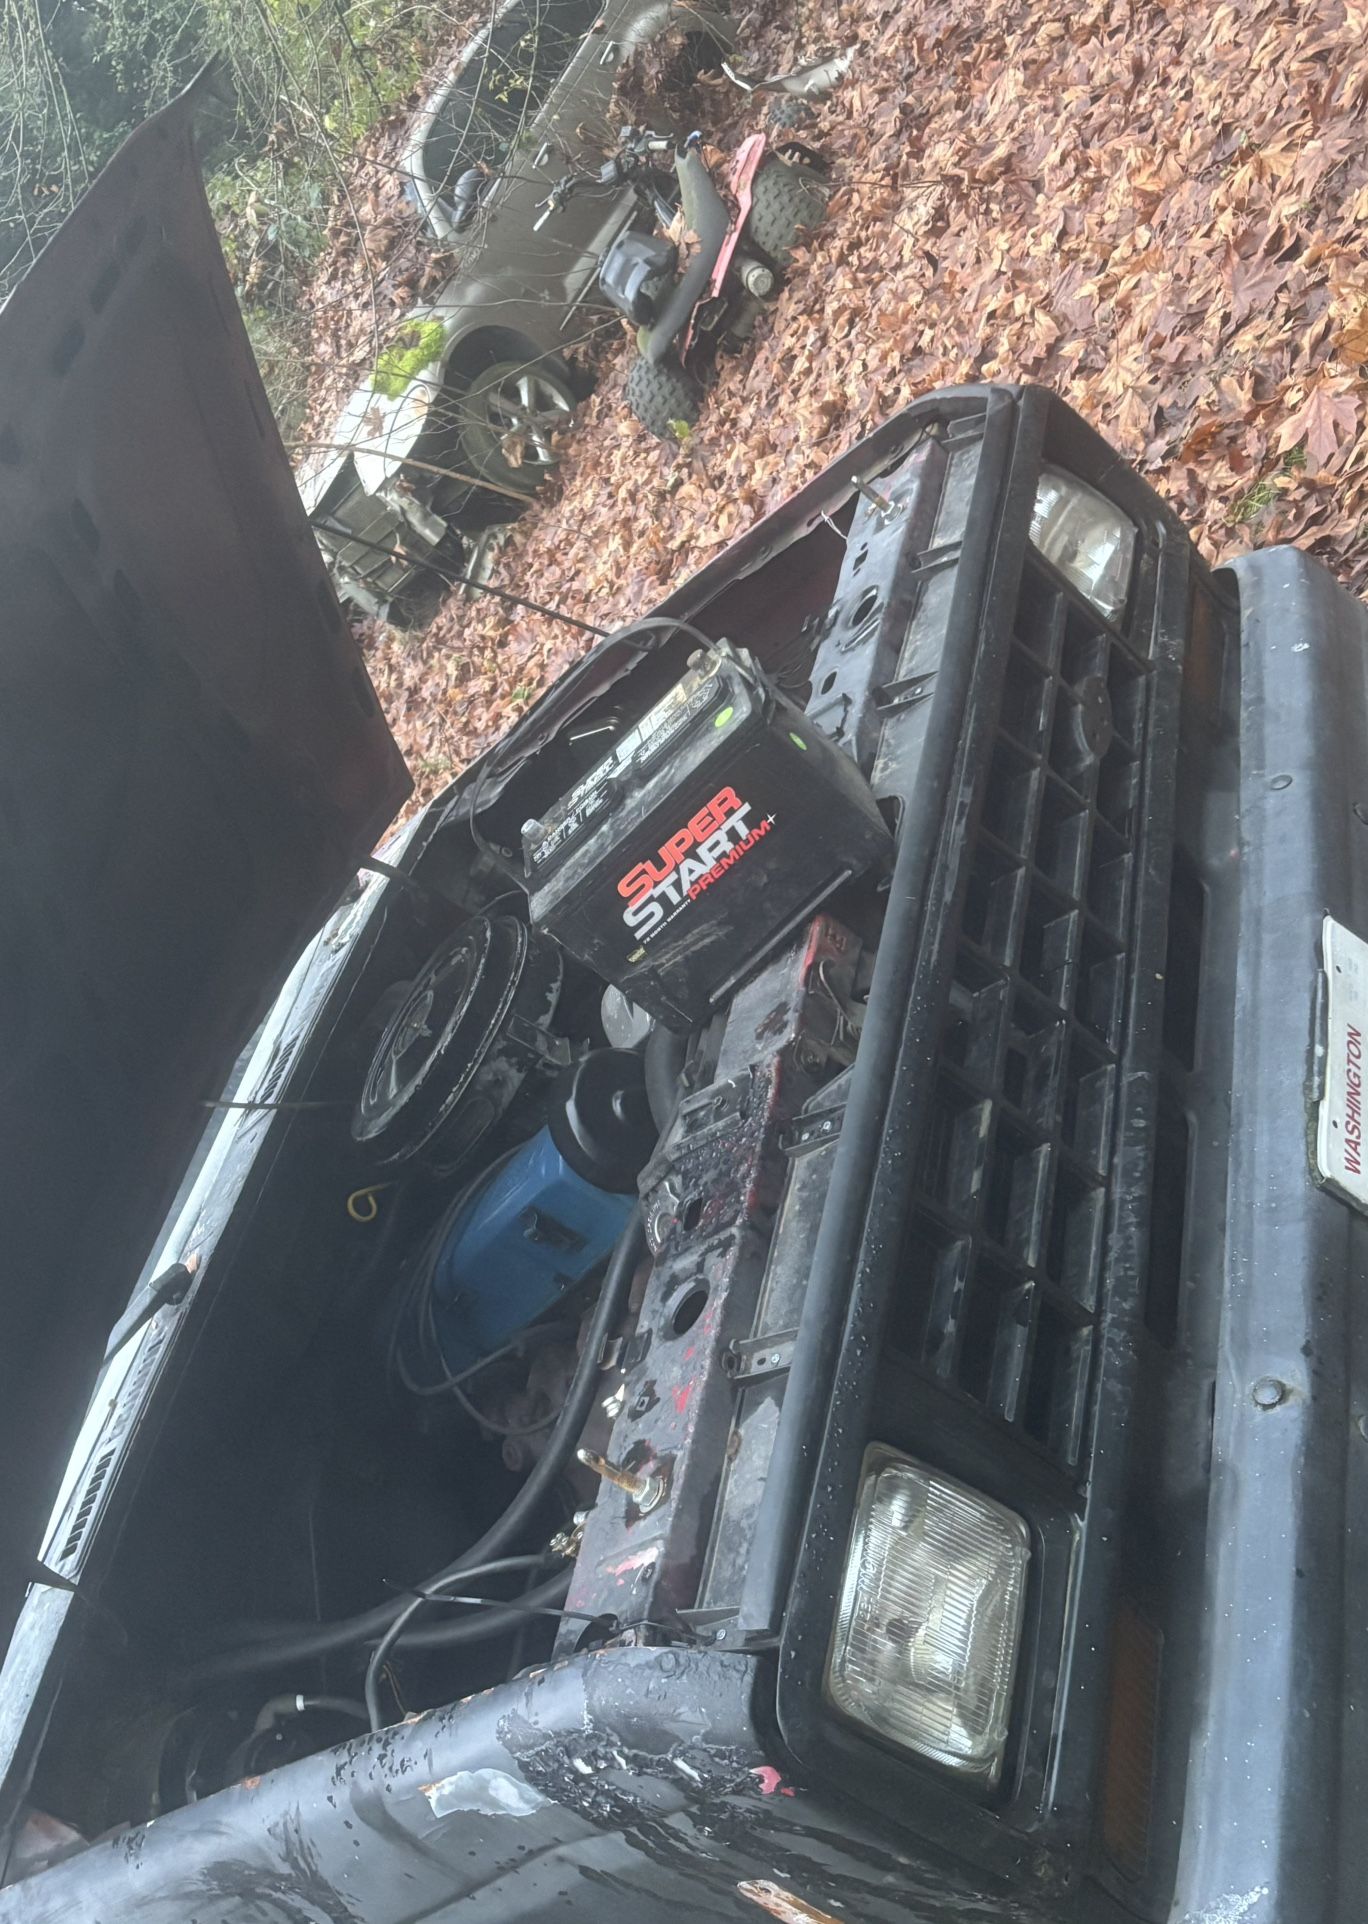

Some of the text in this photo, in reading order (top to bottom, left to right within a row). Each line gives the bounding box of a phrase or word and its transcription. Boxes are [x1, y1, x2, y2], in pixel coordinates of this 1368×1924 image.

[617, 786, 742, 908] SUPER
[623, 802, 751, 940] START
[688, 819, 771, 900] PREMIUM
[1344, 1023, 1362, 1175] WASHINGTON
